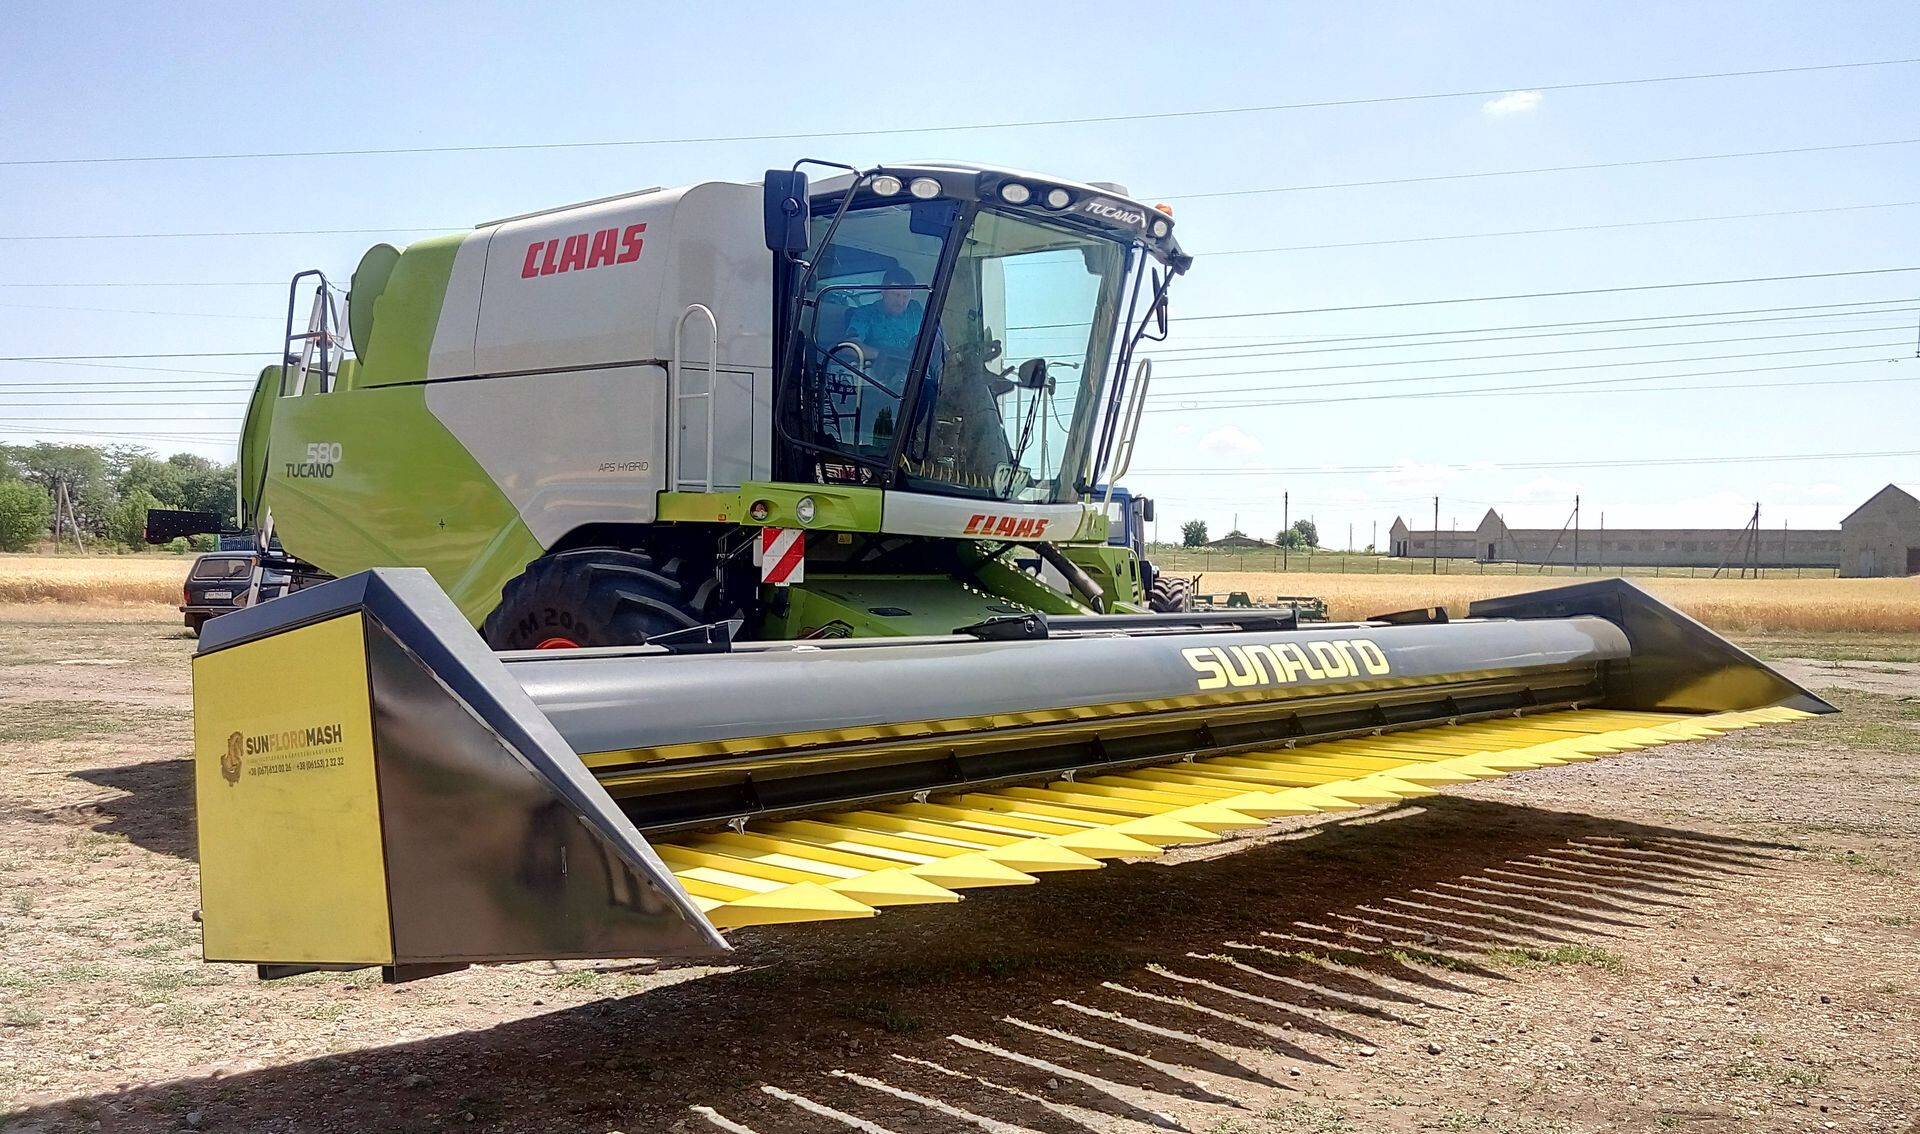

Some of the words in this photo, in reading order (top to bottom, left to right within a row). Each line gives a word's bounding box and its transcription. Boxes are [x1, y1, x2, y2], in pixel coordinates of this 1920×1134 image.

[1085, 202, 1141, 224] TUCANO
[521, 222, 647, 279] CLAAS
[306, 442, 342, 464] 580
[286, 463, 334, 479] TUCANO
[598, 462, 616, 472] APS
[963, 514, 1049, 538] CLAAS
[246, 723, 342, 755] SUNFLOROMASH
[330, 757, 337, 767] 32
[337, 756, 344, 766] 32
